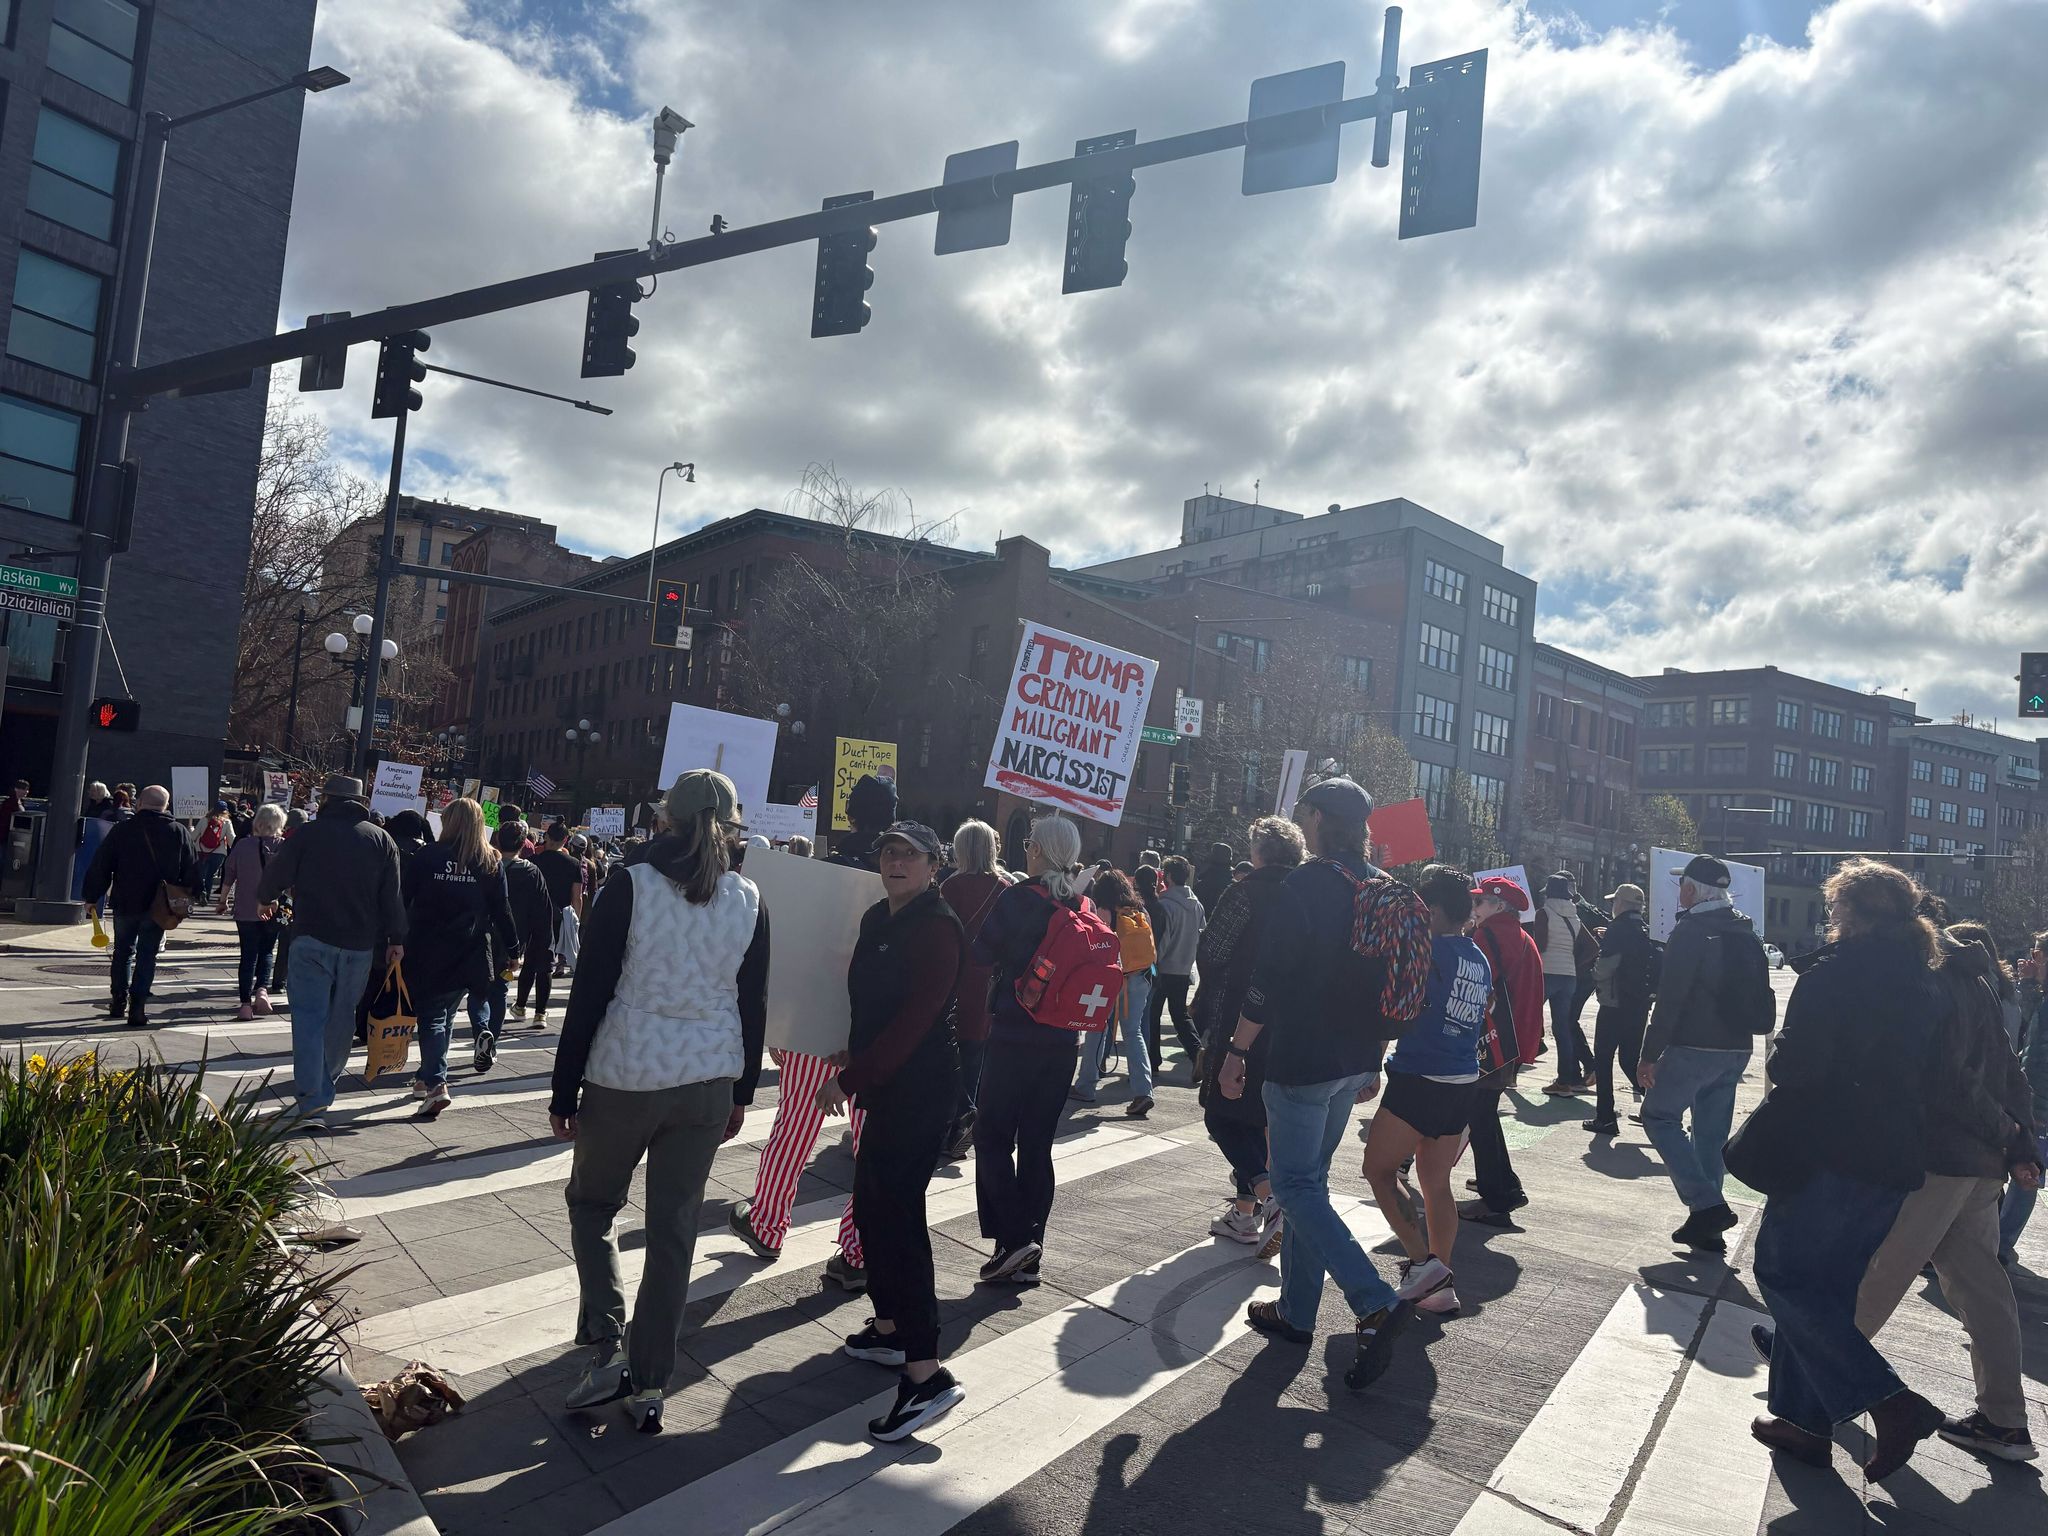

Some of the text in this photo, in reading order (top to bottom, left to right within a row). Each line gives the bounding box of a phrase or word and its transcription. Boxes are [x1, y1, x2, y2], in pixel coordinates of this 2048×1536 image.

[0, 568, 73, 594] laskan Wy
[0, 592, 71, 617] Dzidzilalich
[1033, 631, 1144, 697] TRUMP:
[1017, 673, 1122, 732] CRIMINAL
[1186, 700, 1196, 708] NO
[1182, 707, 1200, 716] TURN
[1011, 706, 1117, 759] MALIGNANT
[1152, 732, 1160, 740] Wy
[842, 742, 891, 761] Duct Tape
[385, 766, 412, 775] American
[868, 761, 878, 770] fix
[380, 780, 412, 791] Leadership
[594, 824, 622, 834] GAVIN
[446, 874, 466, 882] POWER
[1457, 956, 1485, 983] UNION
